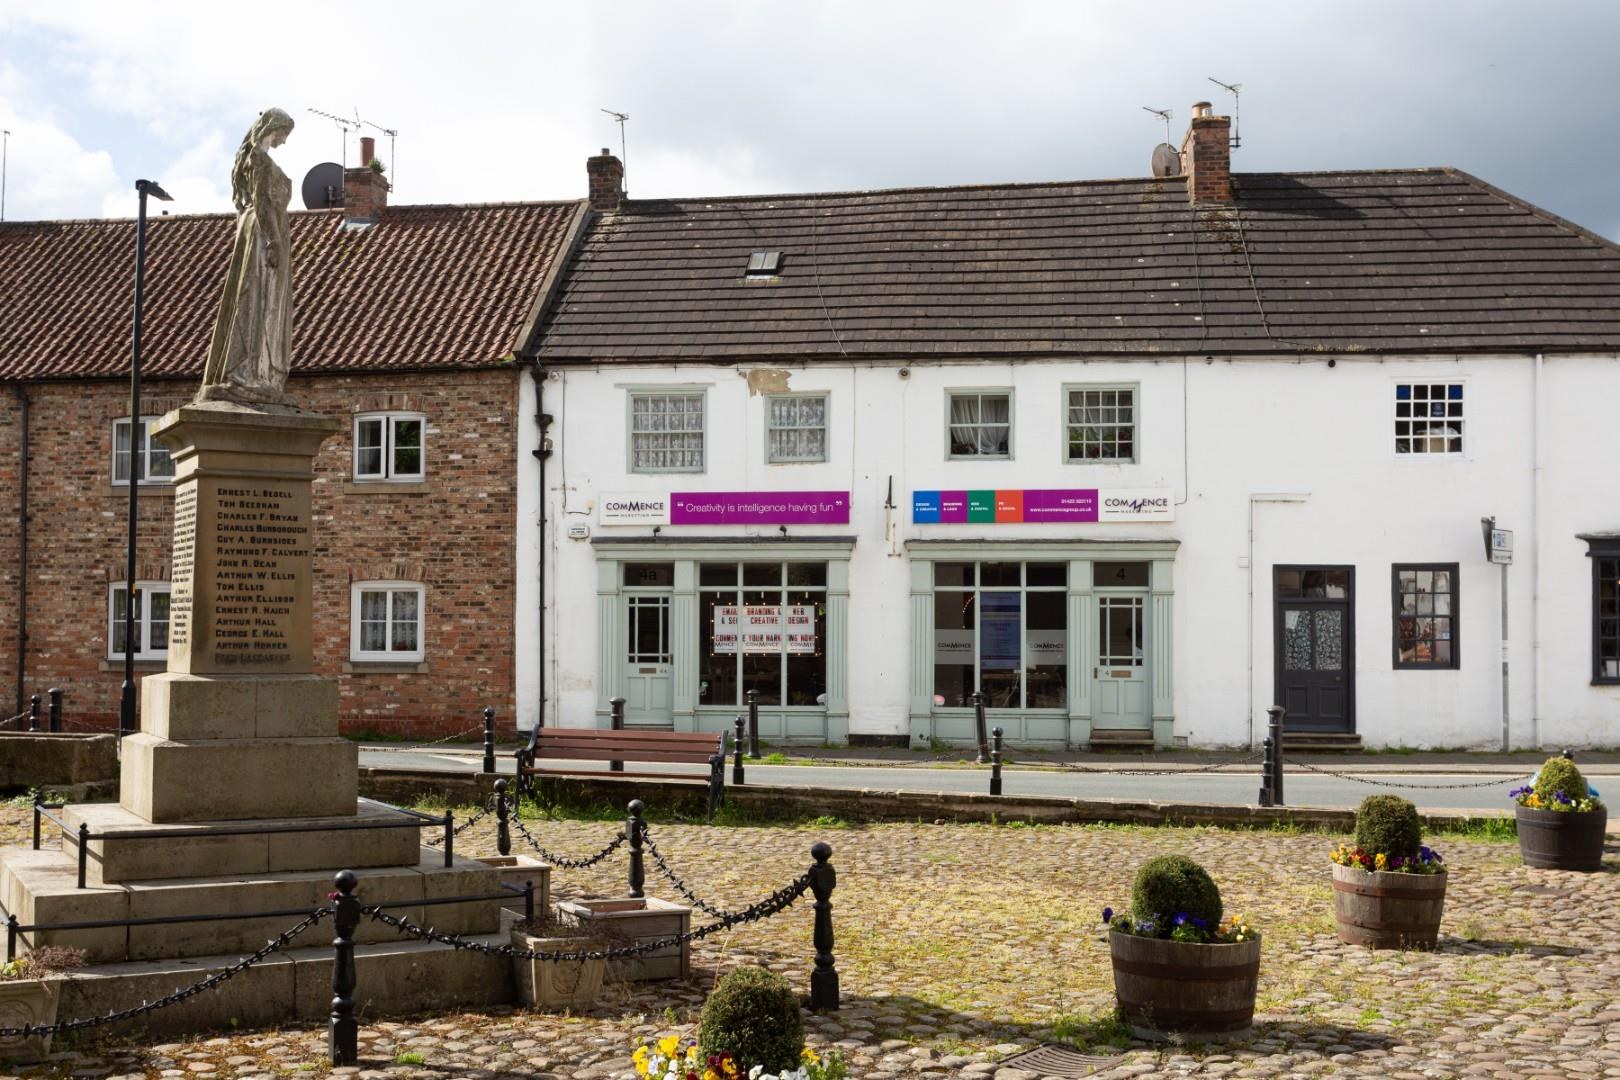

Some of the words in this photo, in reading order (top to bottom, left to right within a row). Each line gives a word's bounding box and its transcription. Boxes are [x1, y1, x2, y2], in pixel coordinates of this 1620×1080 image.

[218, 488, 250, 496] ERNEST
[263, 490, 292, 498] BEDELL
[218, 500, 235, 508] TOM
[606, 501, 664, 511] COMMENCE
[728, 503, 735, 512] is
[737, 503, 786, 514] intelligence
[788, 502, 817, 514] having
[1104, 498, 1168, 512] COMMENCE
[217, 512, 256, 520] CHARLES
[270, 514, 298, 522] BRYAN
[217, 524, 254, 532] CHARLES
[271, 572, 296, 580] ELLIS
[640, 568, 656, 580] 4a
[1116, 568, 1125, 580] 4
[239, 583, 264, 591] ELLIS
[216, 618, 250, 626] ARTHUR
[255, 618, 276, 626] HALL
[748, 634, 763, 642] YOUR
